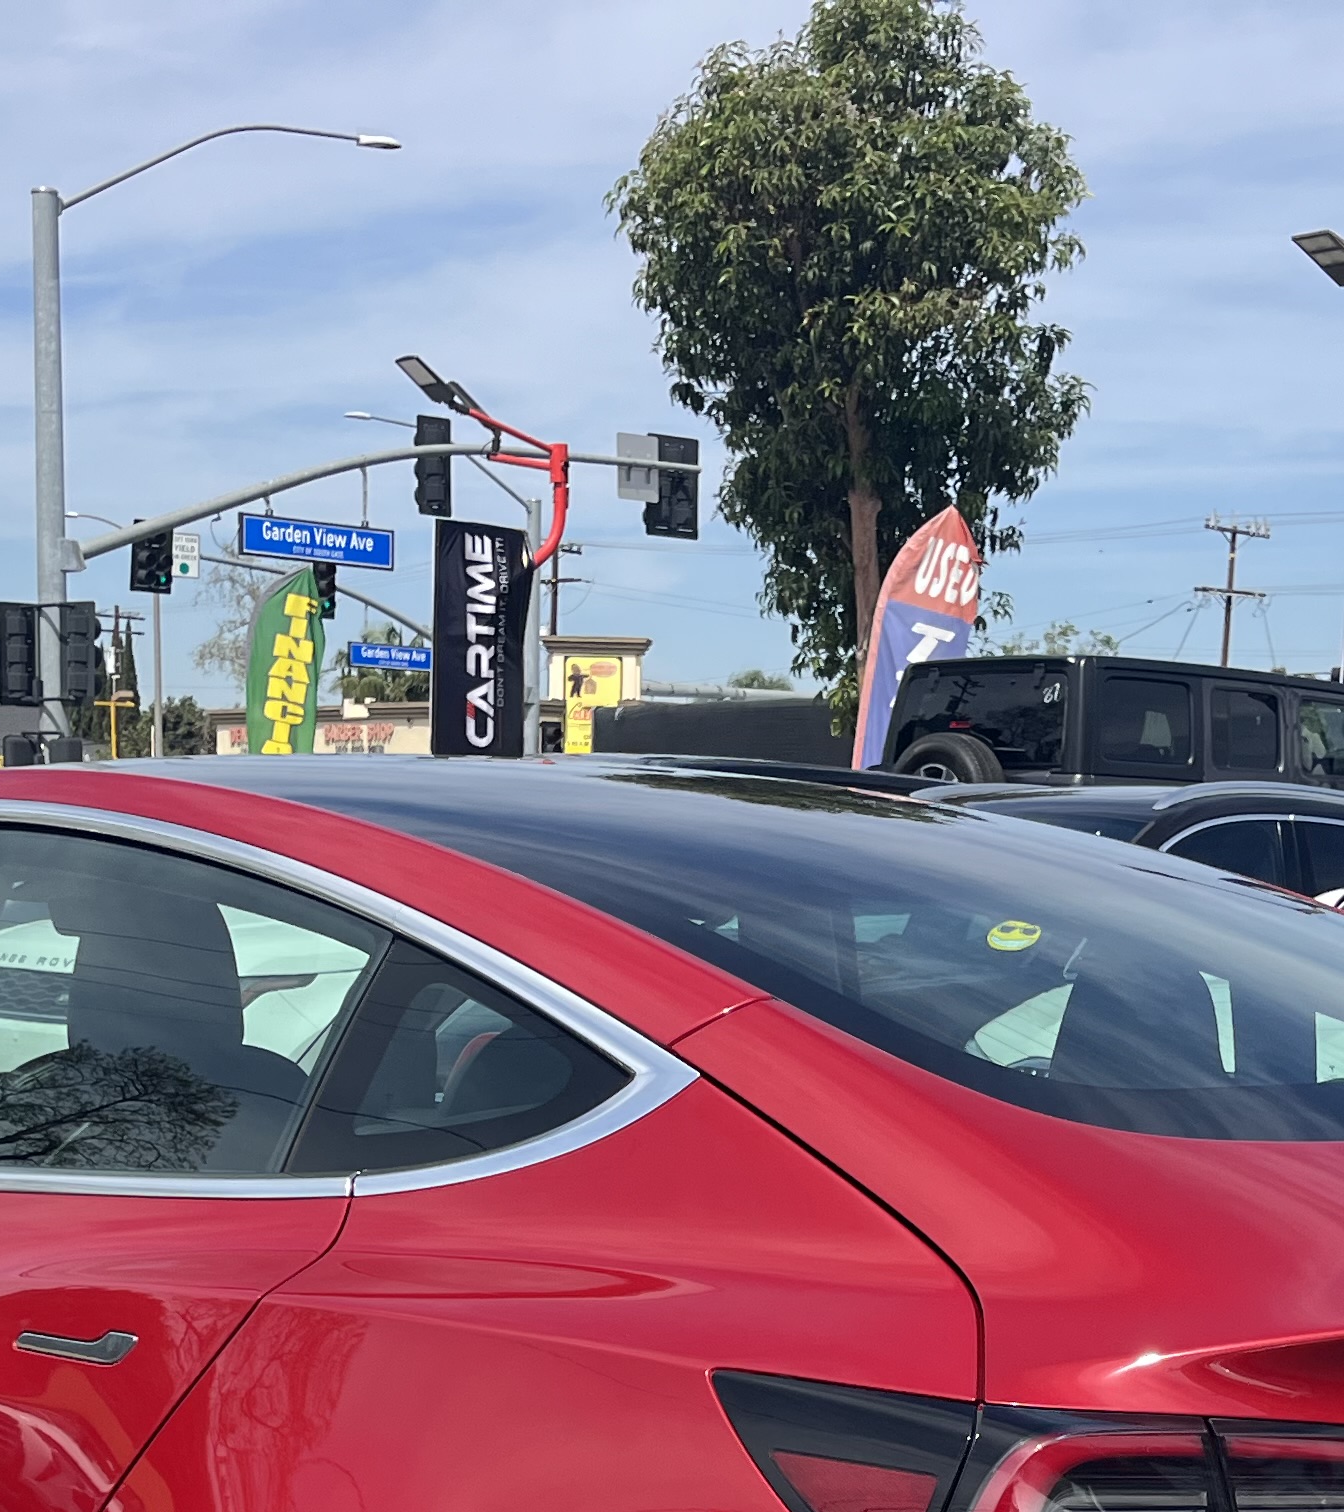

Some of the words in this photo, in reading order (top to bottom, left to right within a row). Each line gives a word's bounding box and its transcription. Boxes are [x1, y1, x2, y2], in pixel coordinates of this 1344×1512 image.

[262, 521, 311, 545] Garden
[313, 526, 347, 549] View
[349, 531, 374, 552] Ave
[496, 556, 509, 594] DRIVE
[360, 646, 390, 659] Garden
[390, 649, 410, 660] View
[411, 650, 426, 662] Ave
[464, 532, 497, 748] CARTIME
